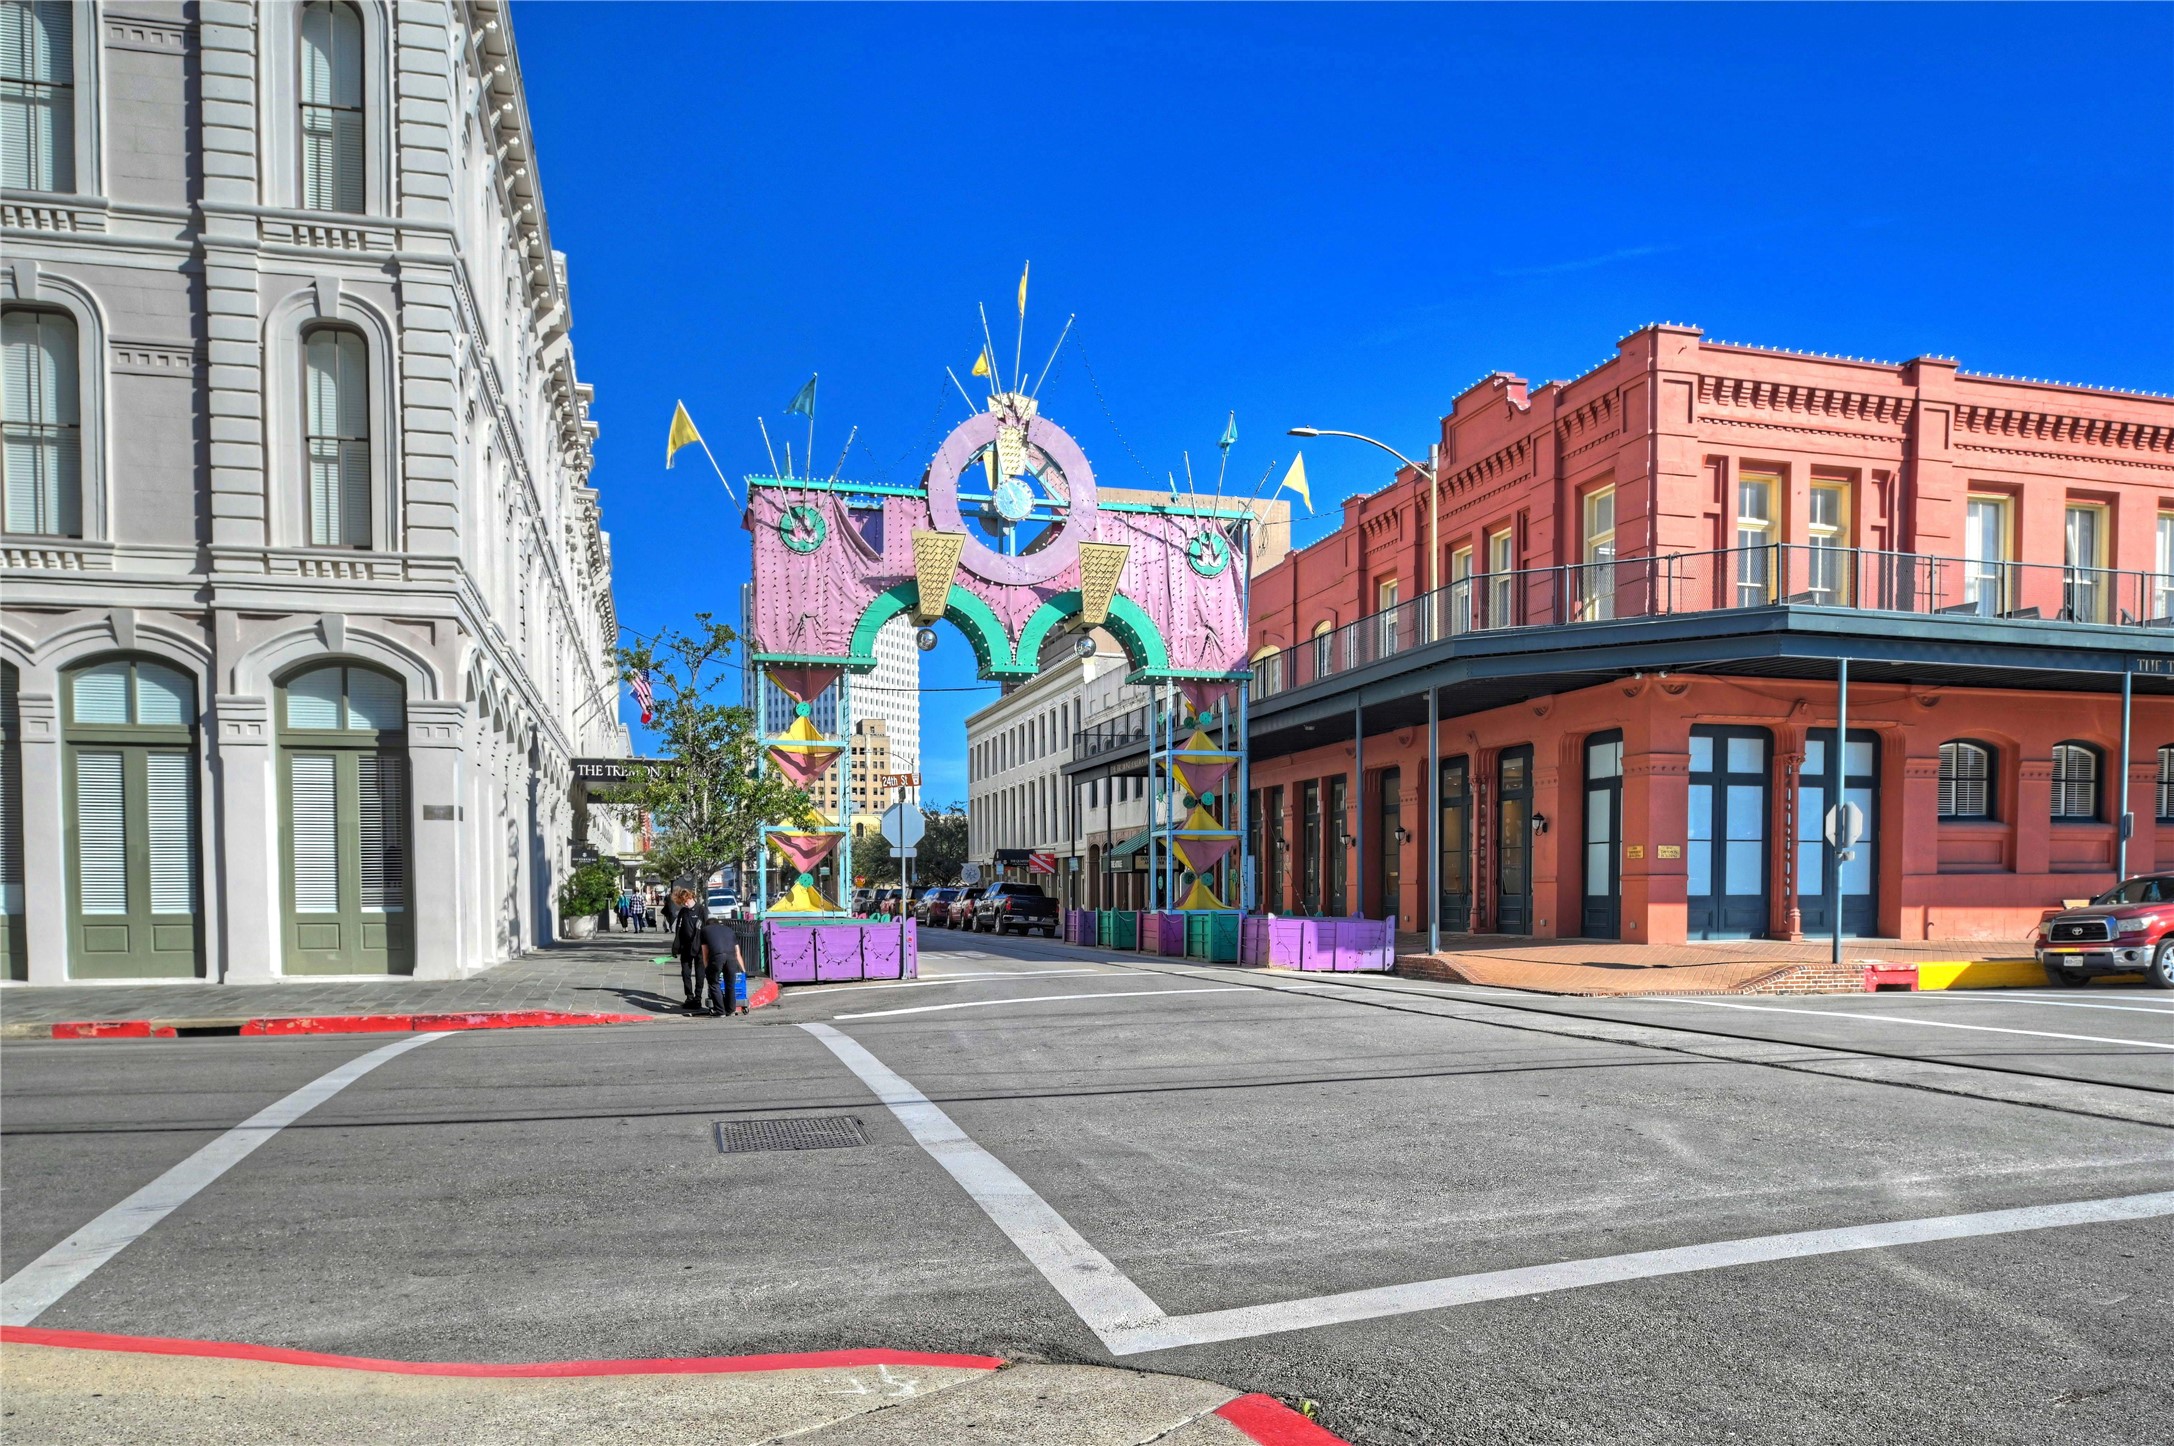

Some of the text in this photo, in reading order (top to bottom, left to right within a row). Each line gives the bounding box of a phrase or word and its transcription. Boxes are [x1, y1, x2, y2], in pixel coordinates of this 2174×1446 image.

[2137, 659, 2162, 672] THE
[577, 764, 603, 776] THE
[605, 765, 664, 778] TREMON
[882, 775, 908, 787] 24th St
